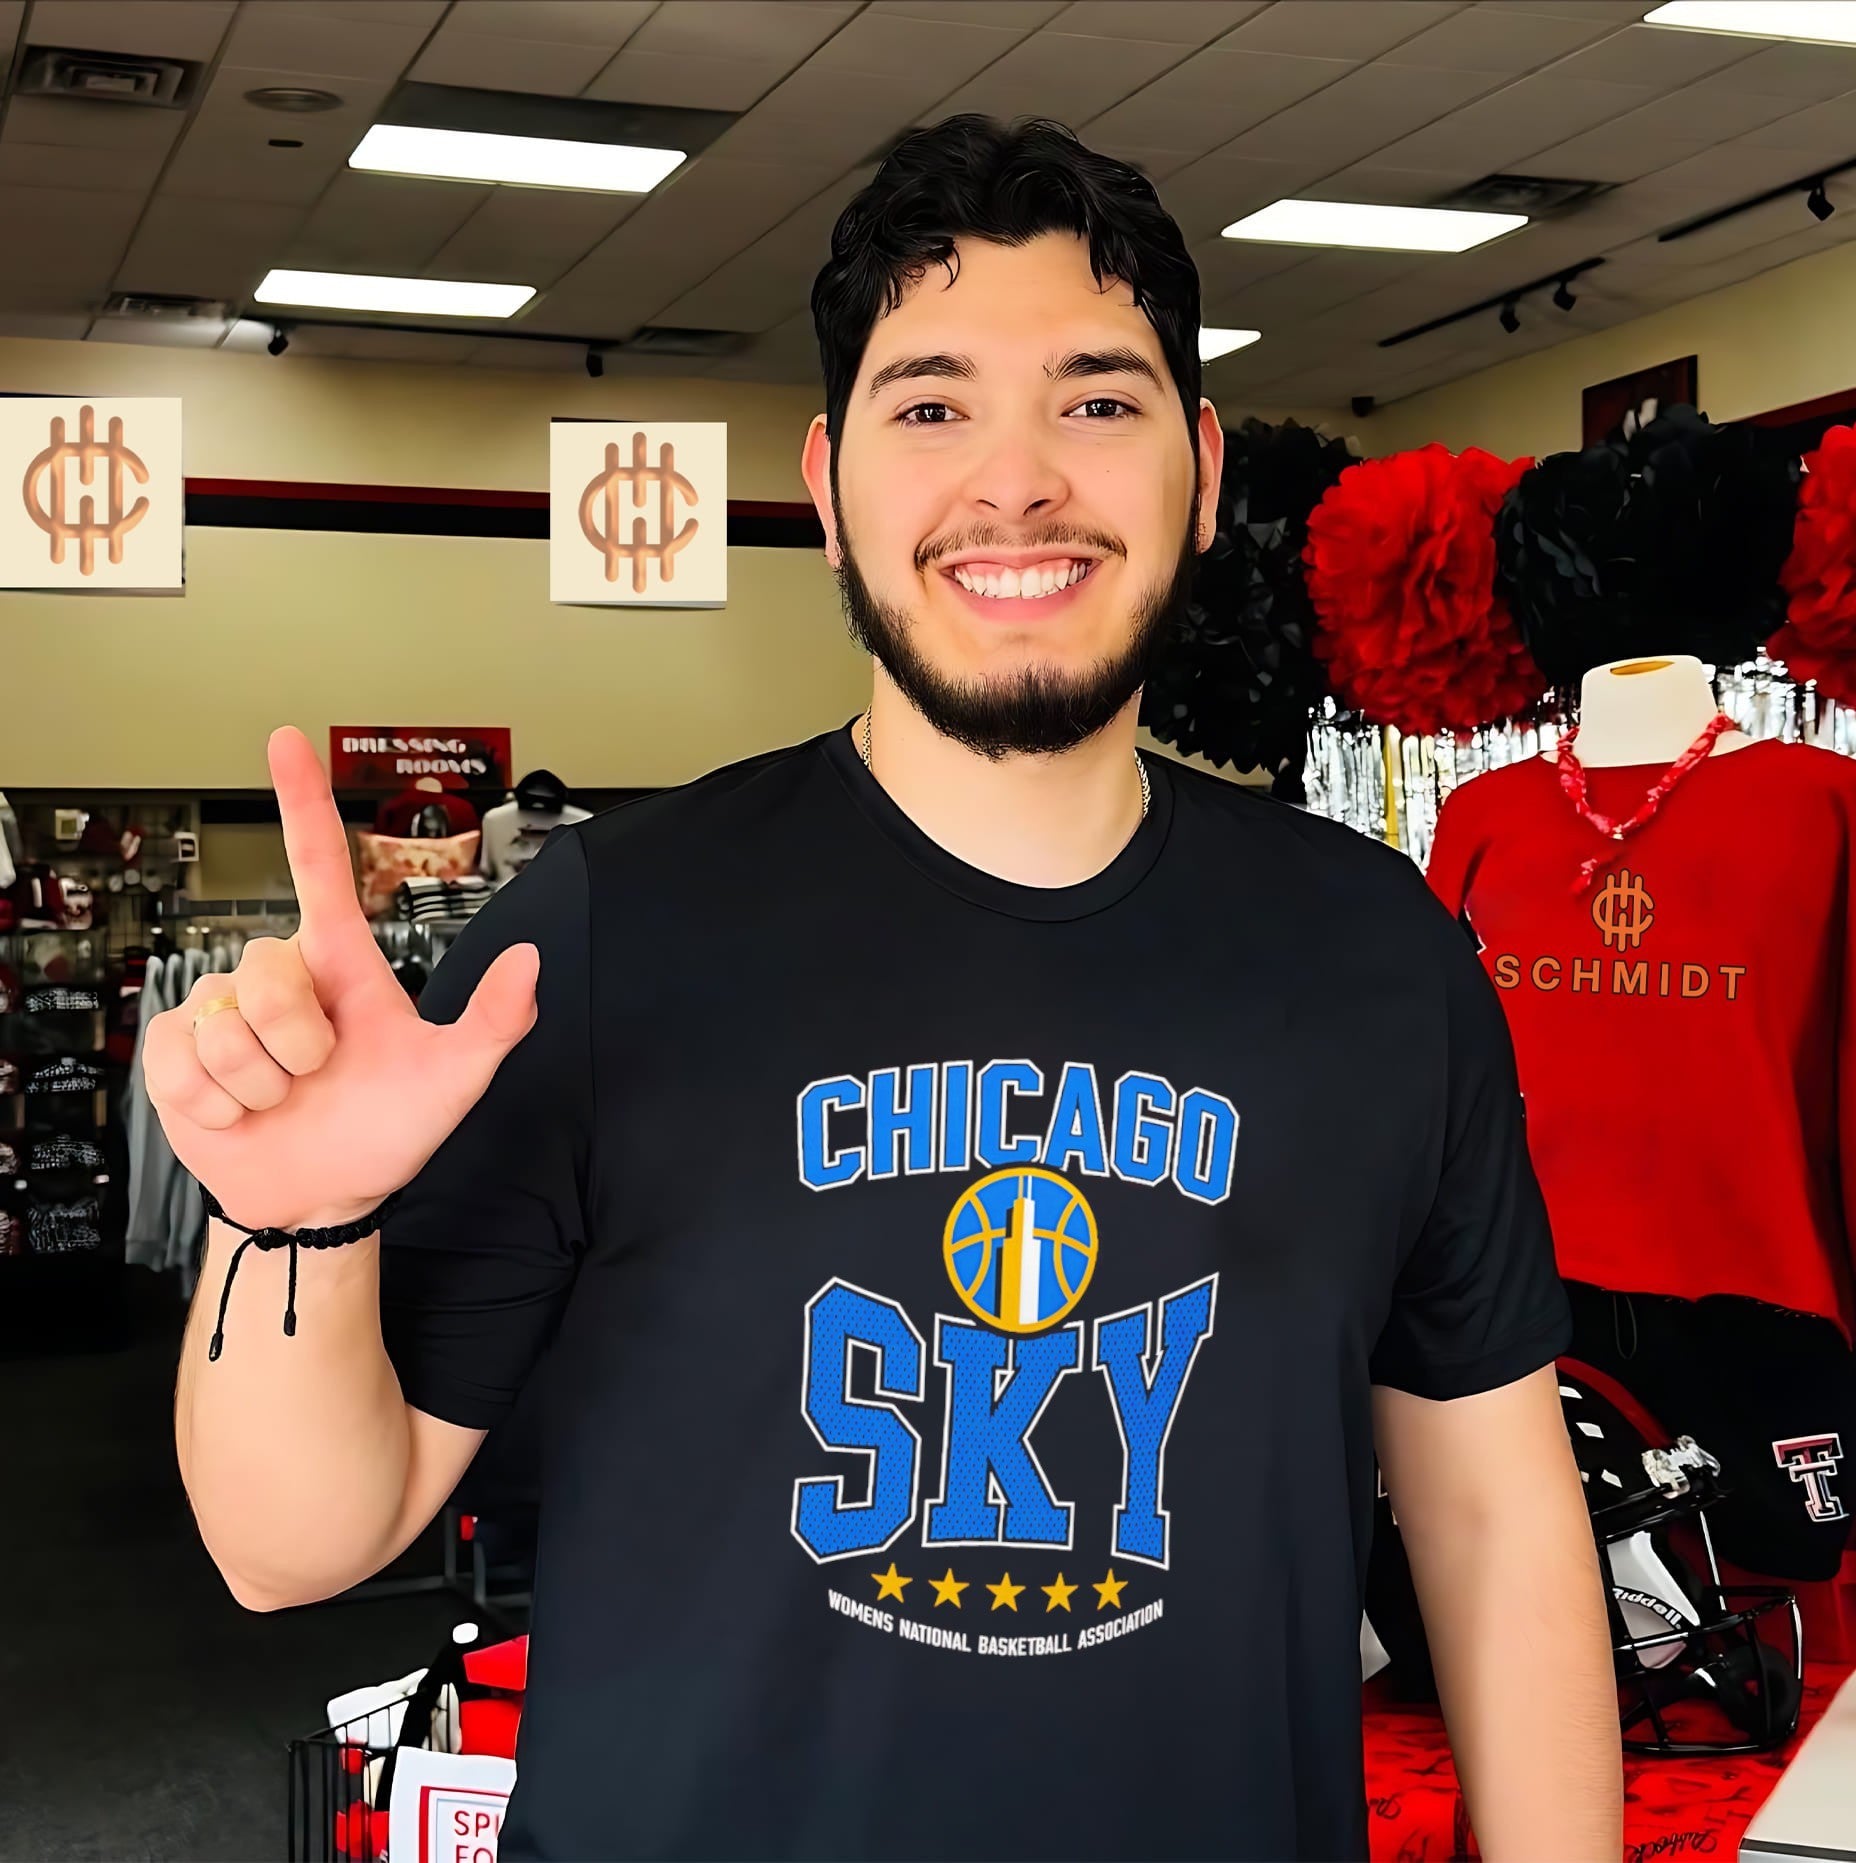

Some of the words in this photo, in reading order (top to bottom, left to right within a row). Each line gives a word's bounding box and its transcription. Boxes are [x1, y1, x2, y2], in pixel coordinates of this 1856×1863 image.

[342, 737, 467, 754] DRESSING
[396, 758, 487, 775] ROOMS
[1494, 953, 1746, 1000] SCHMIDT
[797, 1059, 1239, 1205] CHICAGO
[790, 1272, 1219, 1570] SKY
[828, 1588, 894, 1633] WOMENS
[899, 1618, 972, 1653] NATIONAL
[977, 1633, 1072, 1657] BASKETBALL
[1076, 1598, 1164, 1650] ASSOCIATION
